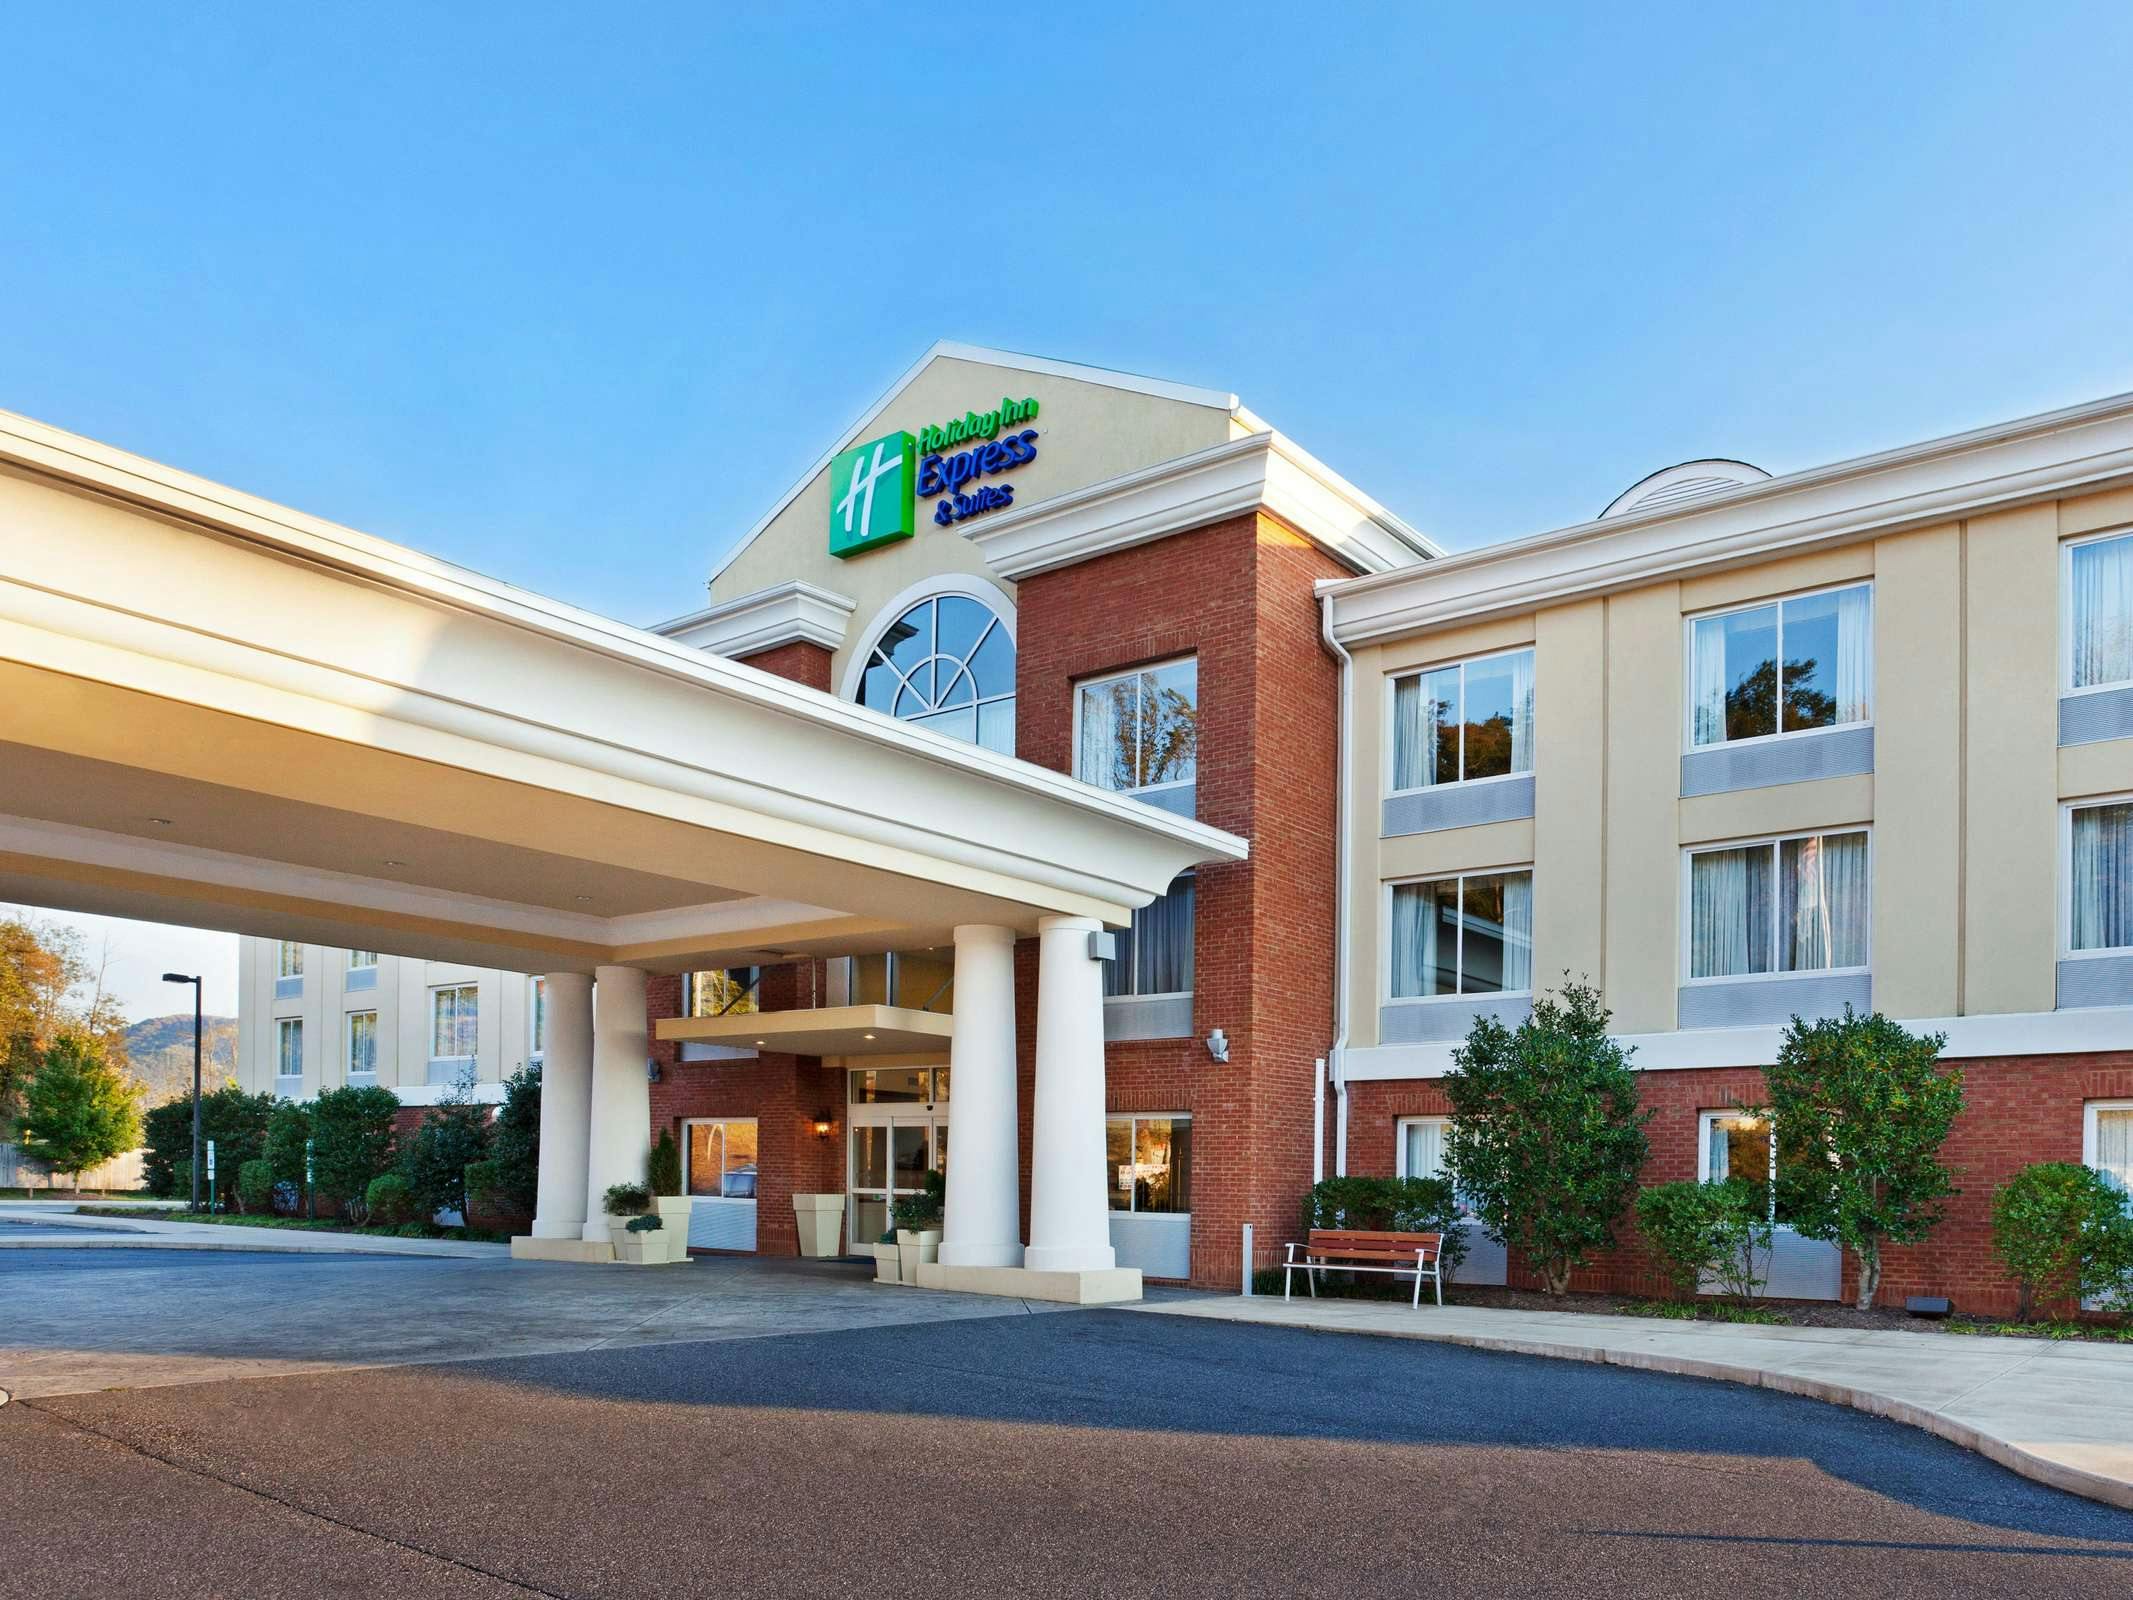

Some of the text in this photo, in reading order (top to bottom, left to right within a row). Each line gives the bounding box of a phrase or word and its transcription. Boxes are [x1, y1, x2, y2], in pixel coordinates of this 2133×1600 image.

[917, 397, 1039, 455] Holiday Inn
[917, 430, 1038, 497] Express
[934, 484, 1014, 526] & Suites
